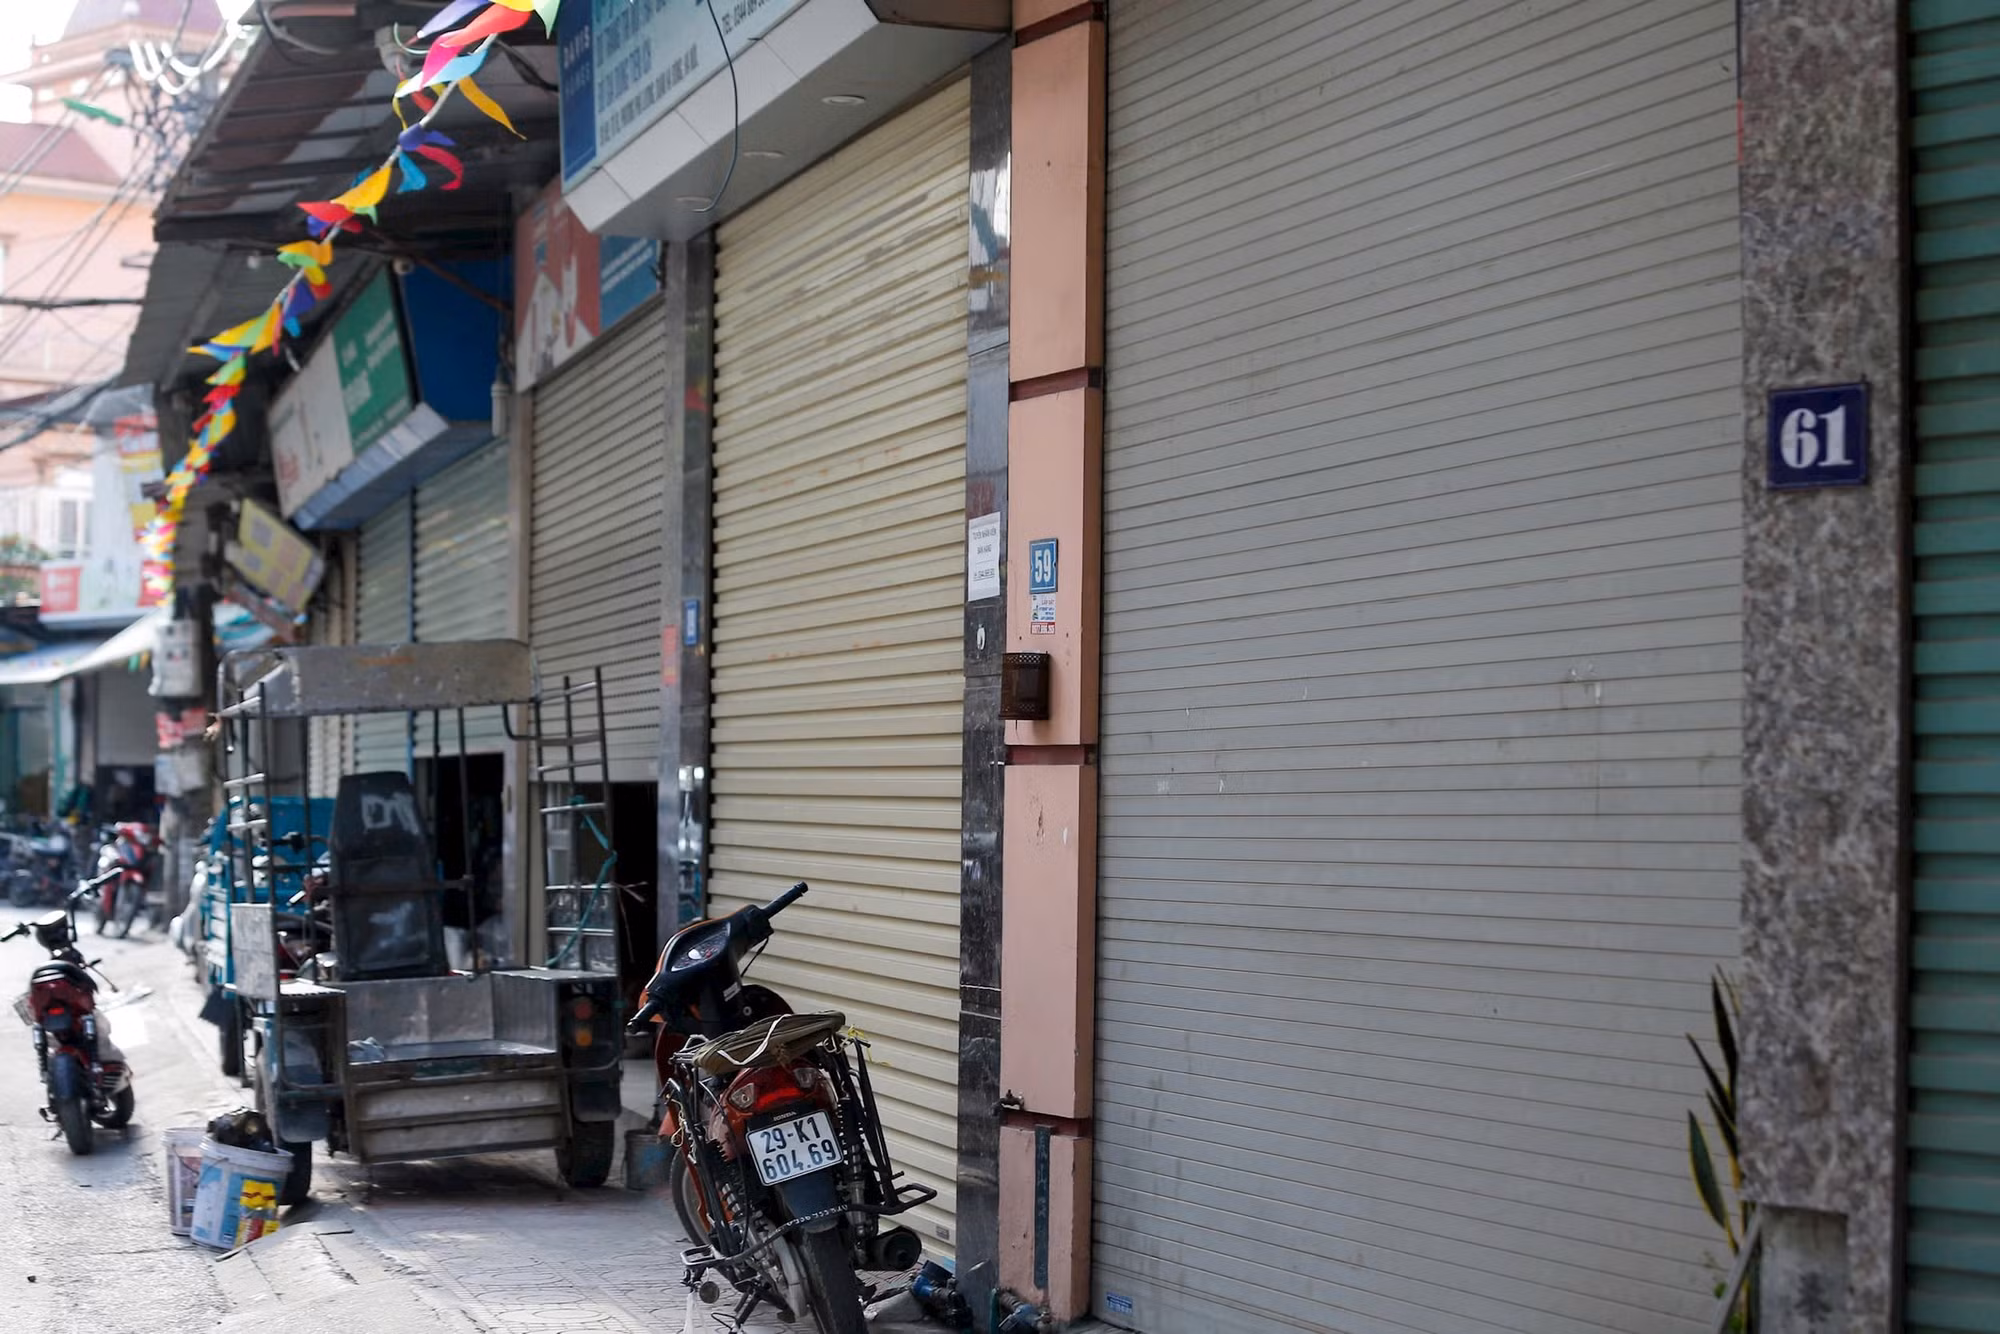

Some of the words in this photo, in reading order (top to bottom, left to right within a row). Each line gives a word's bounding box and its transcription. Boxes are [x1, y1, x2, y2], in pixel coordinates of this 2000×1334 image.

[1780, 405, 1854, 469] 61
[1034, 548, 1051, 583] 59
[760, 1116, 821, 1154] 29-K1
[762, 1139, 837, 1180] 604.69
